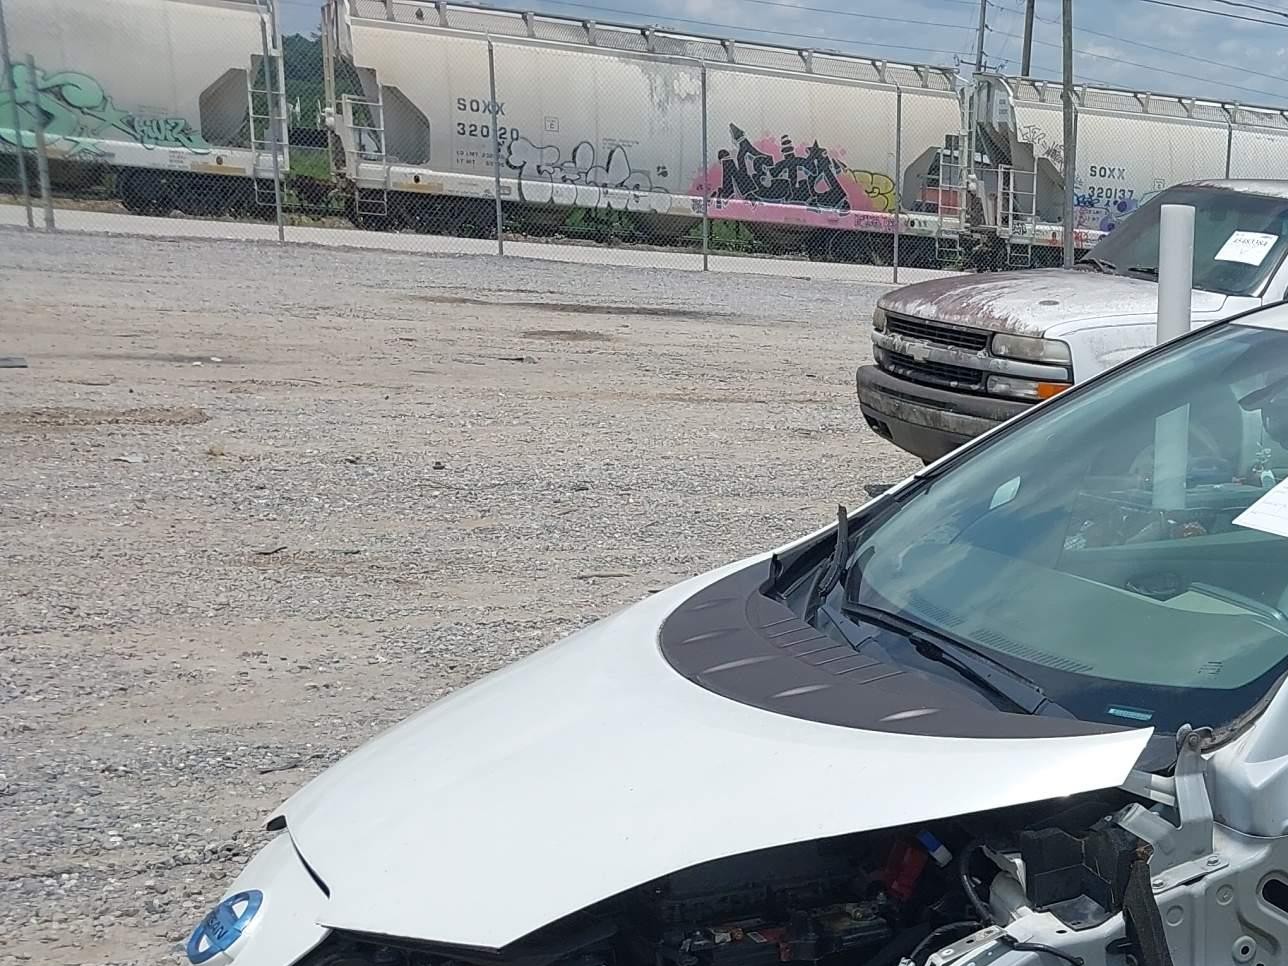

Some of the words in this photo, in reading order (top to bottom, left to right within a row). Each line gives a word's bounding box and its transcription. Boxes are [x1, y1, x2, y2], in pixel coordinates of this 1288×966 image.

[457, 97, 505, 116] SOXX
[456, 122, 520, 141] 32020
[1089, 165, 1126, 179] SOXX
[1087, 186, 1135, 200] 320137
